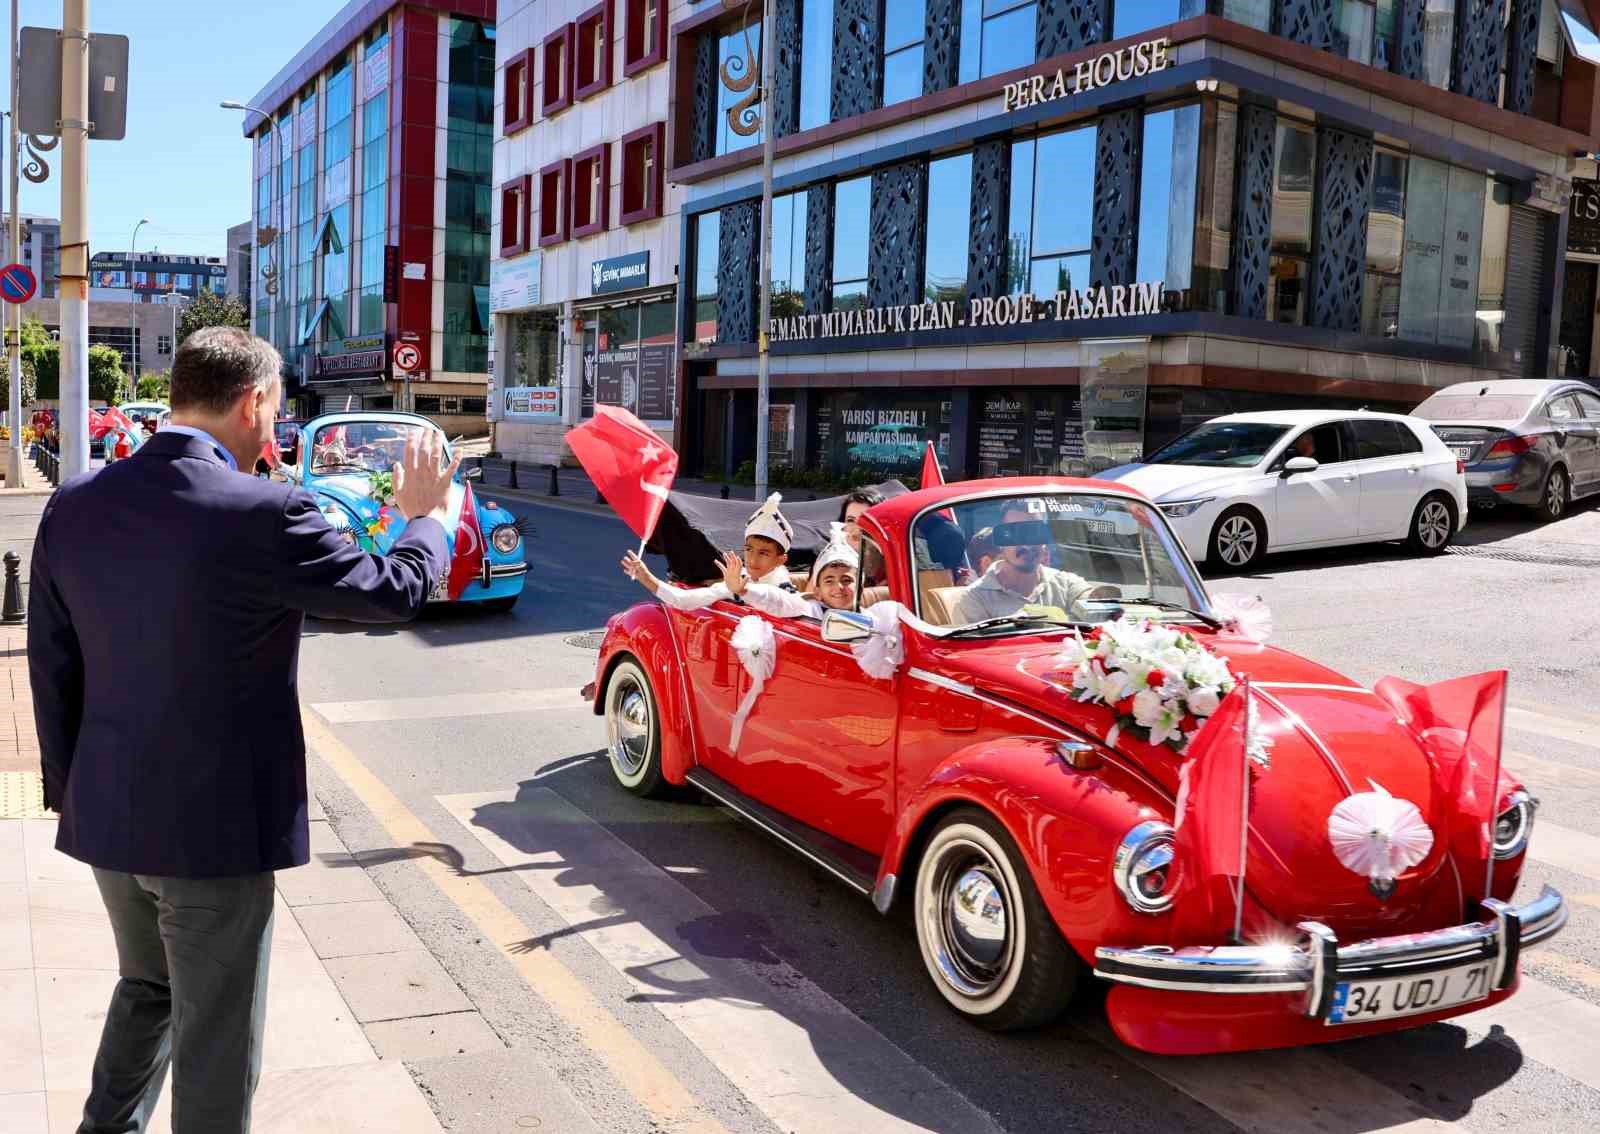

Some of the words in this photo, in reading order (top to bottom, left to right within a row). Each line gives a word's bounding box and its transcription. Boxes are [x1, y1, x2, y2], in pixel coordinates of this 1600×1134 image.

[1072, 37, 1168, 95] HOUSE
[908, 300, 956, 332] PLAN
[969, 293, 1033, 327] PROJE
[1054, 280, 1162, 321] TASARIM
[841, 409, 875, 425] YARISI
[1346, 985, 1382, 1017] 34
[1391, 975, 1449, 1012] UDJ
[1462, 967, 1489, 1000] 71
